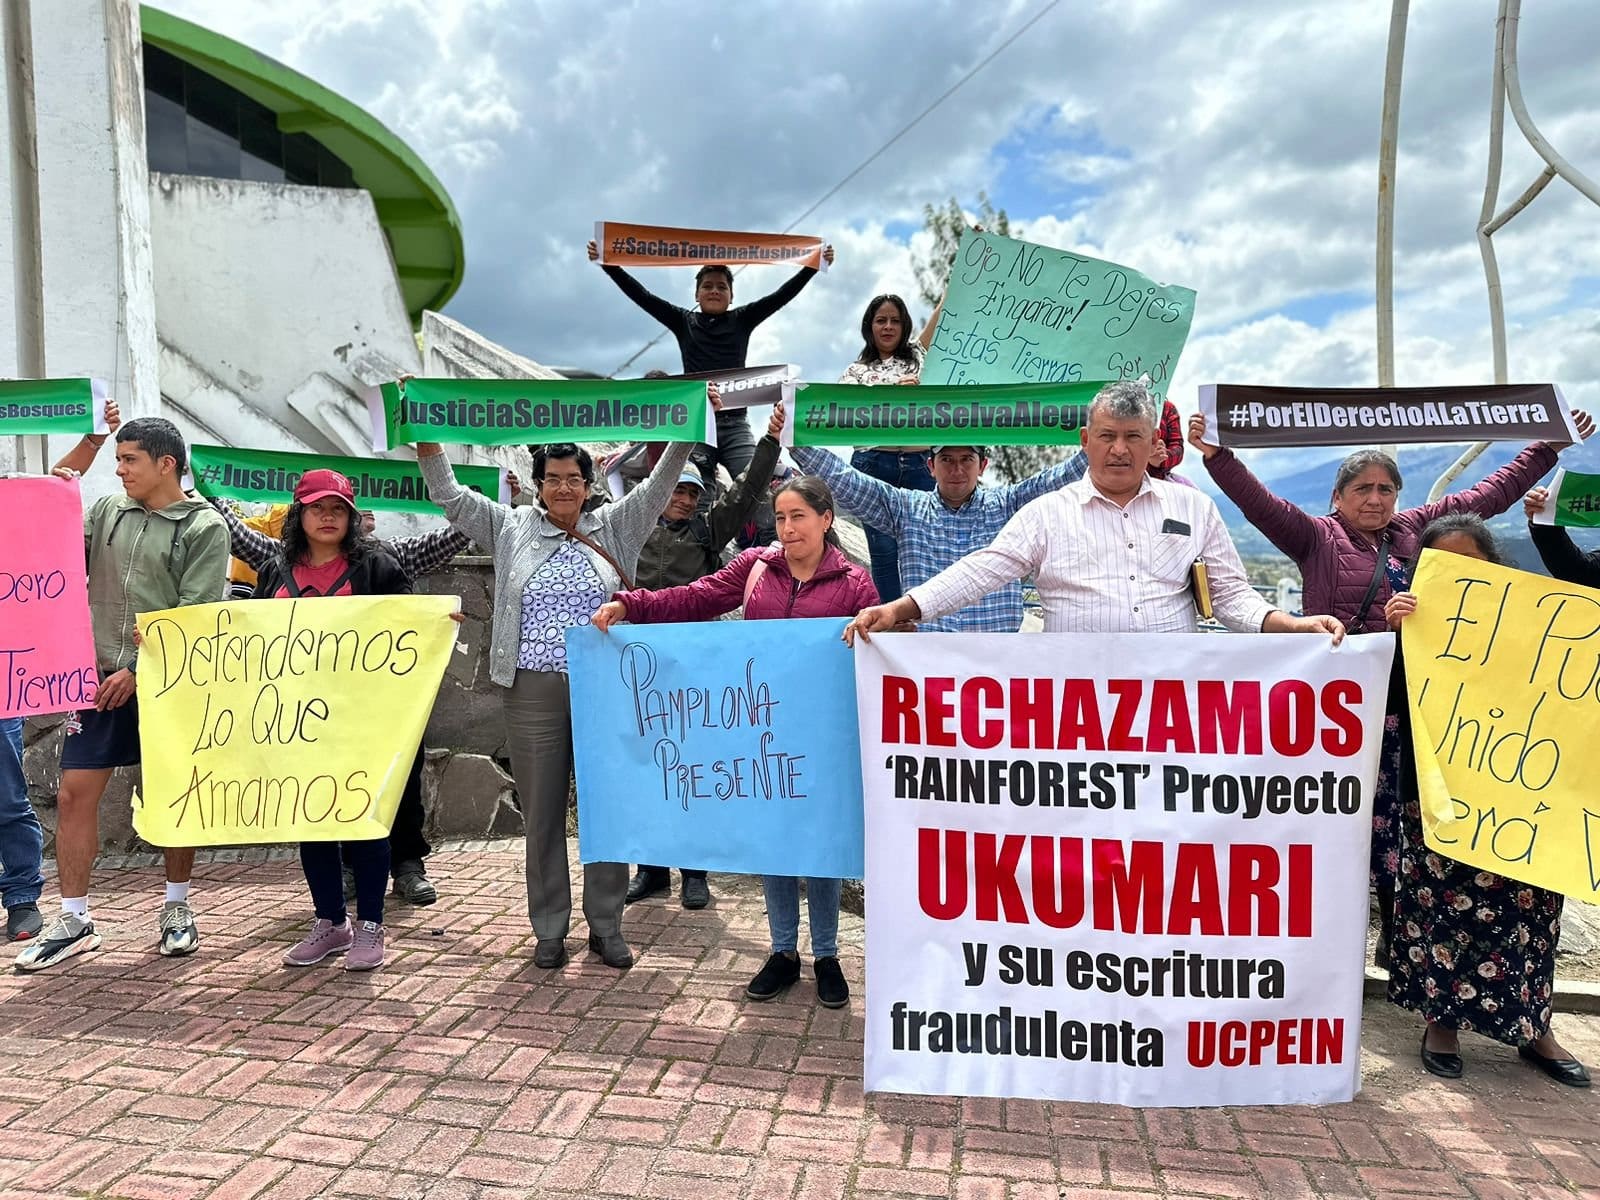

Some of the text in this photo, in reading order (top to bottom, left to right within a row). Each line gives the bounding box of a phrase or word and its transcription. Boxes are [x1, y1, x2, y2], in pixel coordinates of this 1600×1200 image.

[961, 237, 1183, 338] Ojo No Te Dejes
[974, 280, 1090, 340] Engañar!
[931, 308, 1083, 383] Estas Tierras
[805, 401, 1088, 431] #JusticiaSelvaAlegr
[1229, 399, 1549, 428] #PorElDerechoALaTierra
[145, 601, 418, 698] Defendemos
[1436, 578, 1600, 701] El Pu
[0, 648, 99, 711] Tierras
[620, 641, 780, 743] PAMPLONA
[881, 674, 1364, 757] RECHAZAMOS
[192, 683, 329, 756] Lo Que
[1418, 678, 1560, 792] Unido
[169, 766, 371, 830] Amamos
[654, 731, 807, 812] PRESENTE
[1163, 764, 1361, 819] Proyecto
[917, 828, 1313, 938] UKUMARI
[962, 942, 1286, 1000] y su escritura
[890, 1001, 1344, 1068] fraudulenta UCPEIN
